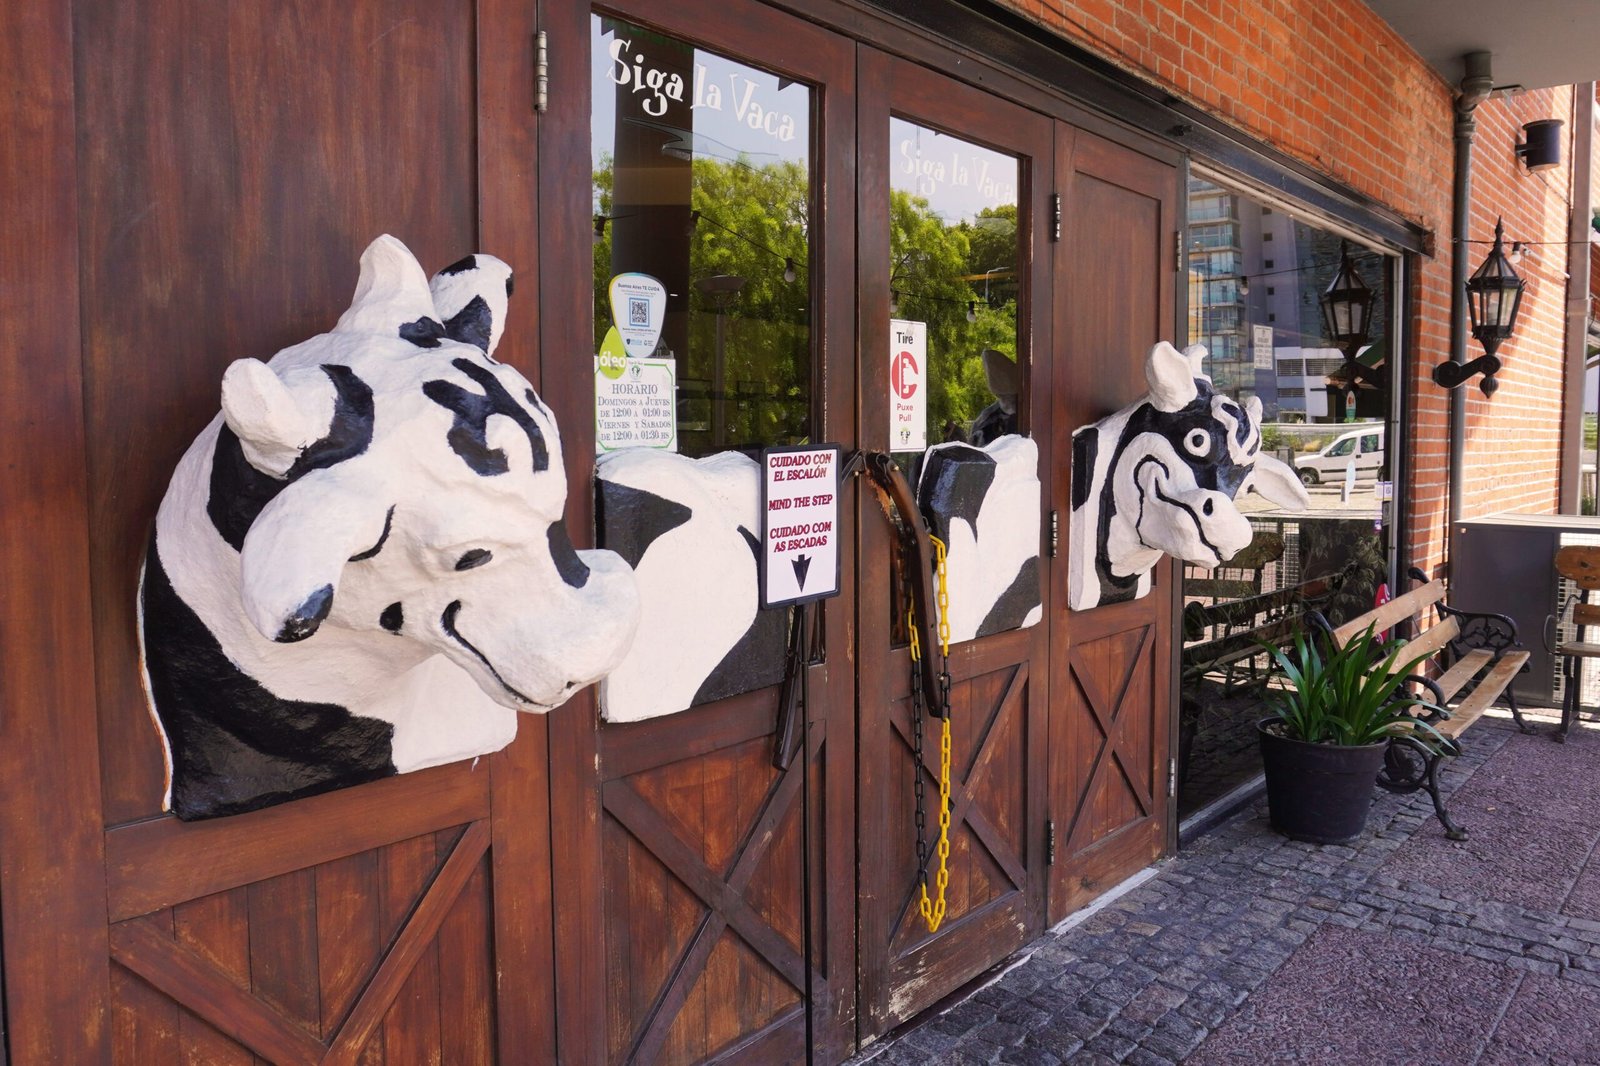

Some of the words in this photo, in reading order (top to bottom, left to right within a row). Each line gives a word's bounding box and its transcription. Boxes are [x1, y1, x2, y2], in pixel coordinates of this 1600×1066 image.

[606, 38, 684, 117] Siga
[690, 63, 722, 111] la
[729, 73, 795, 142] Vaca
[900, 139, 946, 196] Siga
[951, 152, 969, 187] la
[972, 156, 1014, 203] Vaca
[896, 331, 914, 345] Tire
[600, 350, 627, 368] óleo
[612, 383, 658, 395] HORARIO
[598, 396, 637, 406] DOMINGOS
[645, 397, 670, 406] JUEVES
[896, 403, 914, 411] Puxe
[600, 410, 611, 418] DE
[612, 408, 632, 418] 12:00
[642, 408, 661, 418] 01:00
[898, 414, 912, 422] Pull
[598, 419, 630, 429] VIERNES
[601, 433, 611, 441] DE
[613, 431, 633, 441] 12:00
[640, 430, 660, 440] 01:30
[769, 455, 812, 468] CUIDADO
[812, 453, 832, 465] CON
[773, 471, 786, 482] EL
[786, 465, 828, 481] ESCALÓN
[768, 498, 792, 511] MIND
[793, 496, 811, 508] THE
[811, 493, 833, 506] STEP
[769, 524, 811, 539] CUIDADO
[811, 521, 832, 533] COM
[773, 541, 787, 553] AS
[787, 535, 828, 550] ESCADAS
